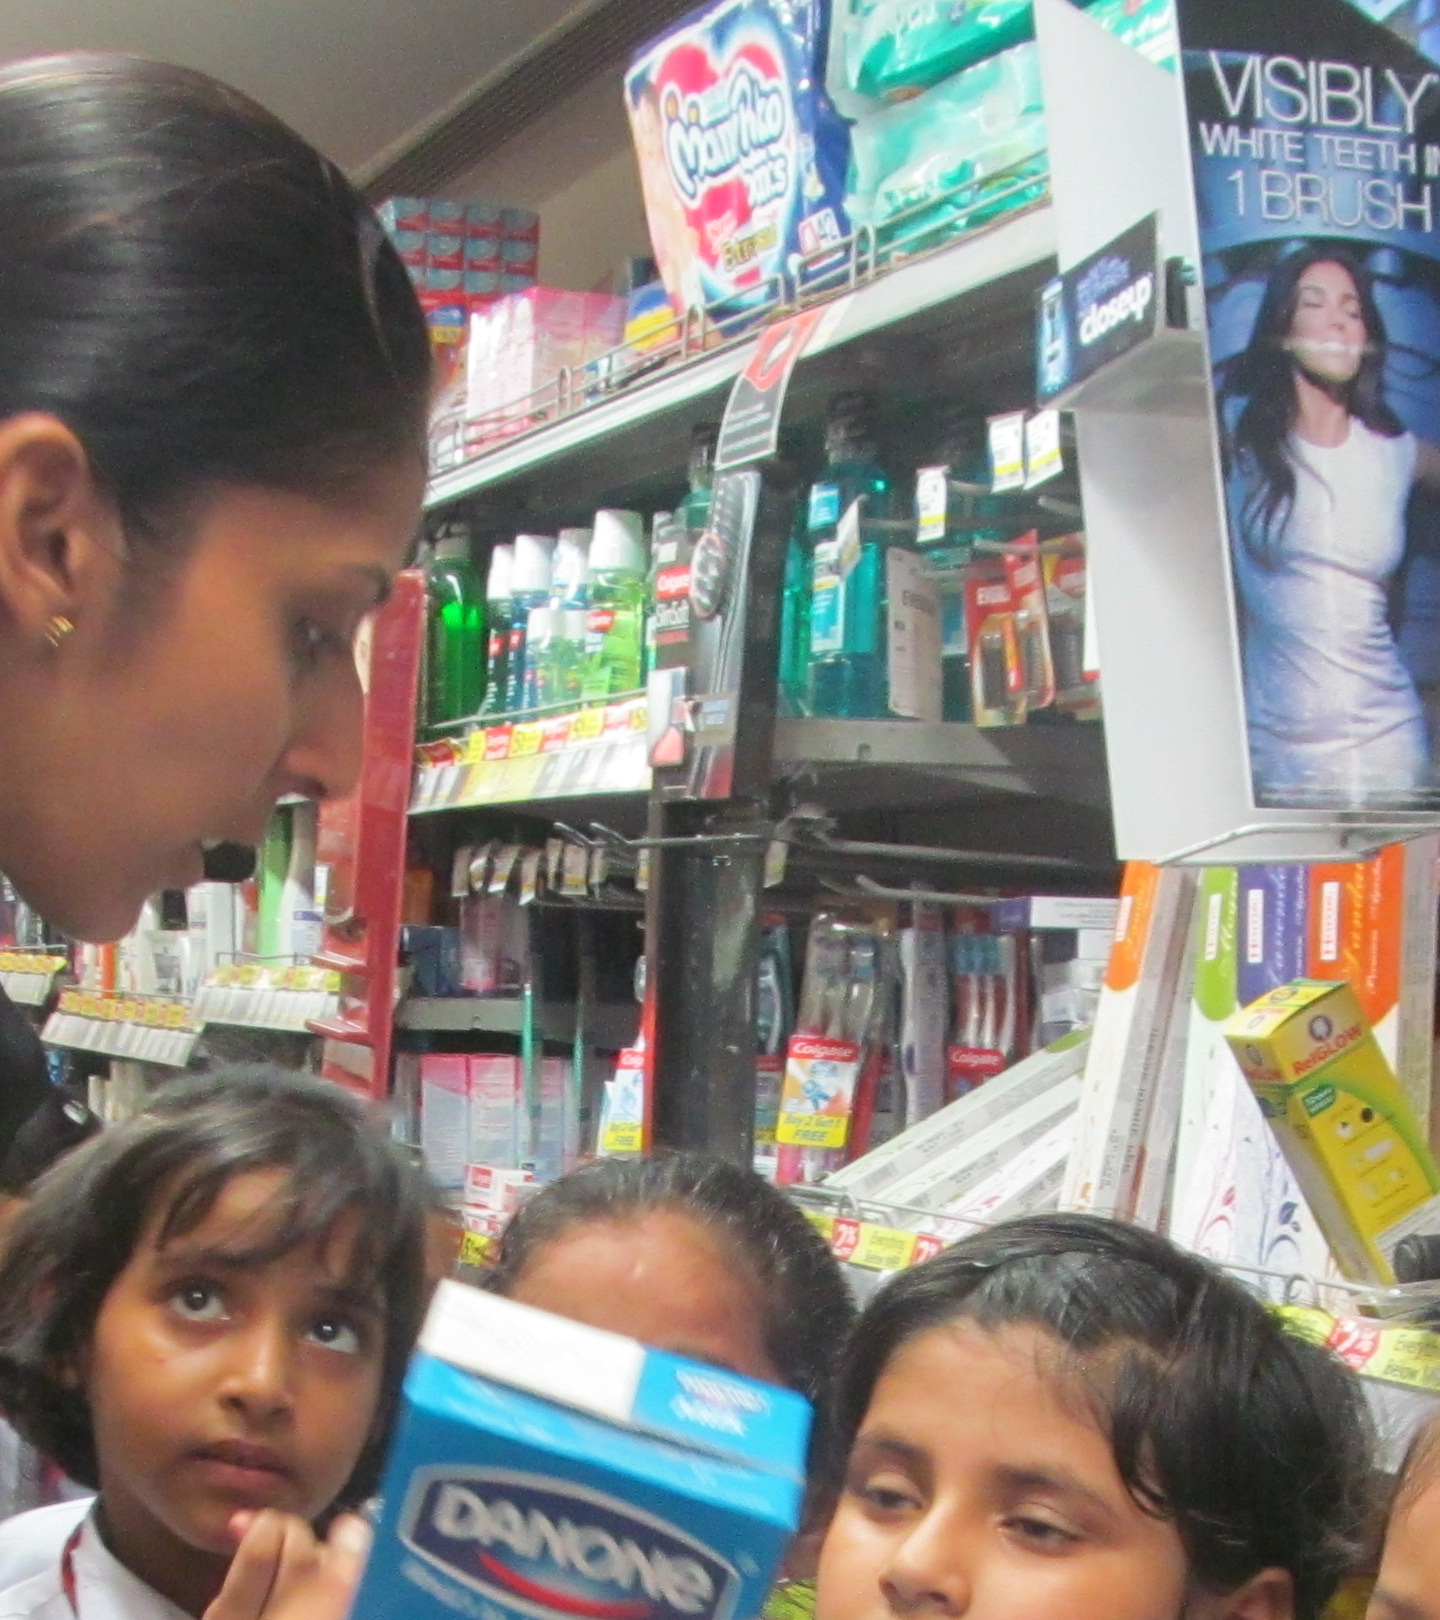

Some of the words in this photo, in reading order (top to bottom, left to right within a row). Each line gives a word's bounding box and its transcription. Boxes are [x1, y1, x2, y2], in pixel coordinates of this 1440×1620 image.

[1209, 49, 1440, 135] VISIBLY
[1199, 121, 1306, 165] WHITE
[1312, 133, 1418, 176] TEETH
[1226, 169, 1246, 217] 1
[1261, 170, 1434, 234] BRUSH
[791, 1041, 853, 1058] Colgate
[433, 1483, 715, 1614] DANONE
